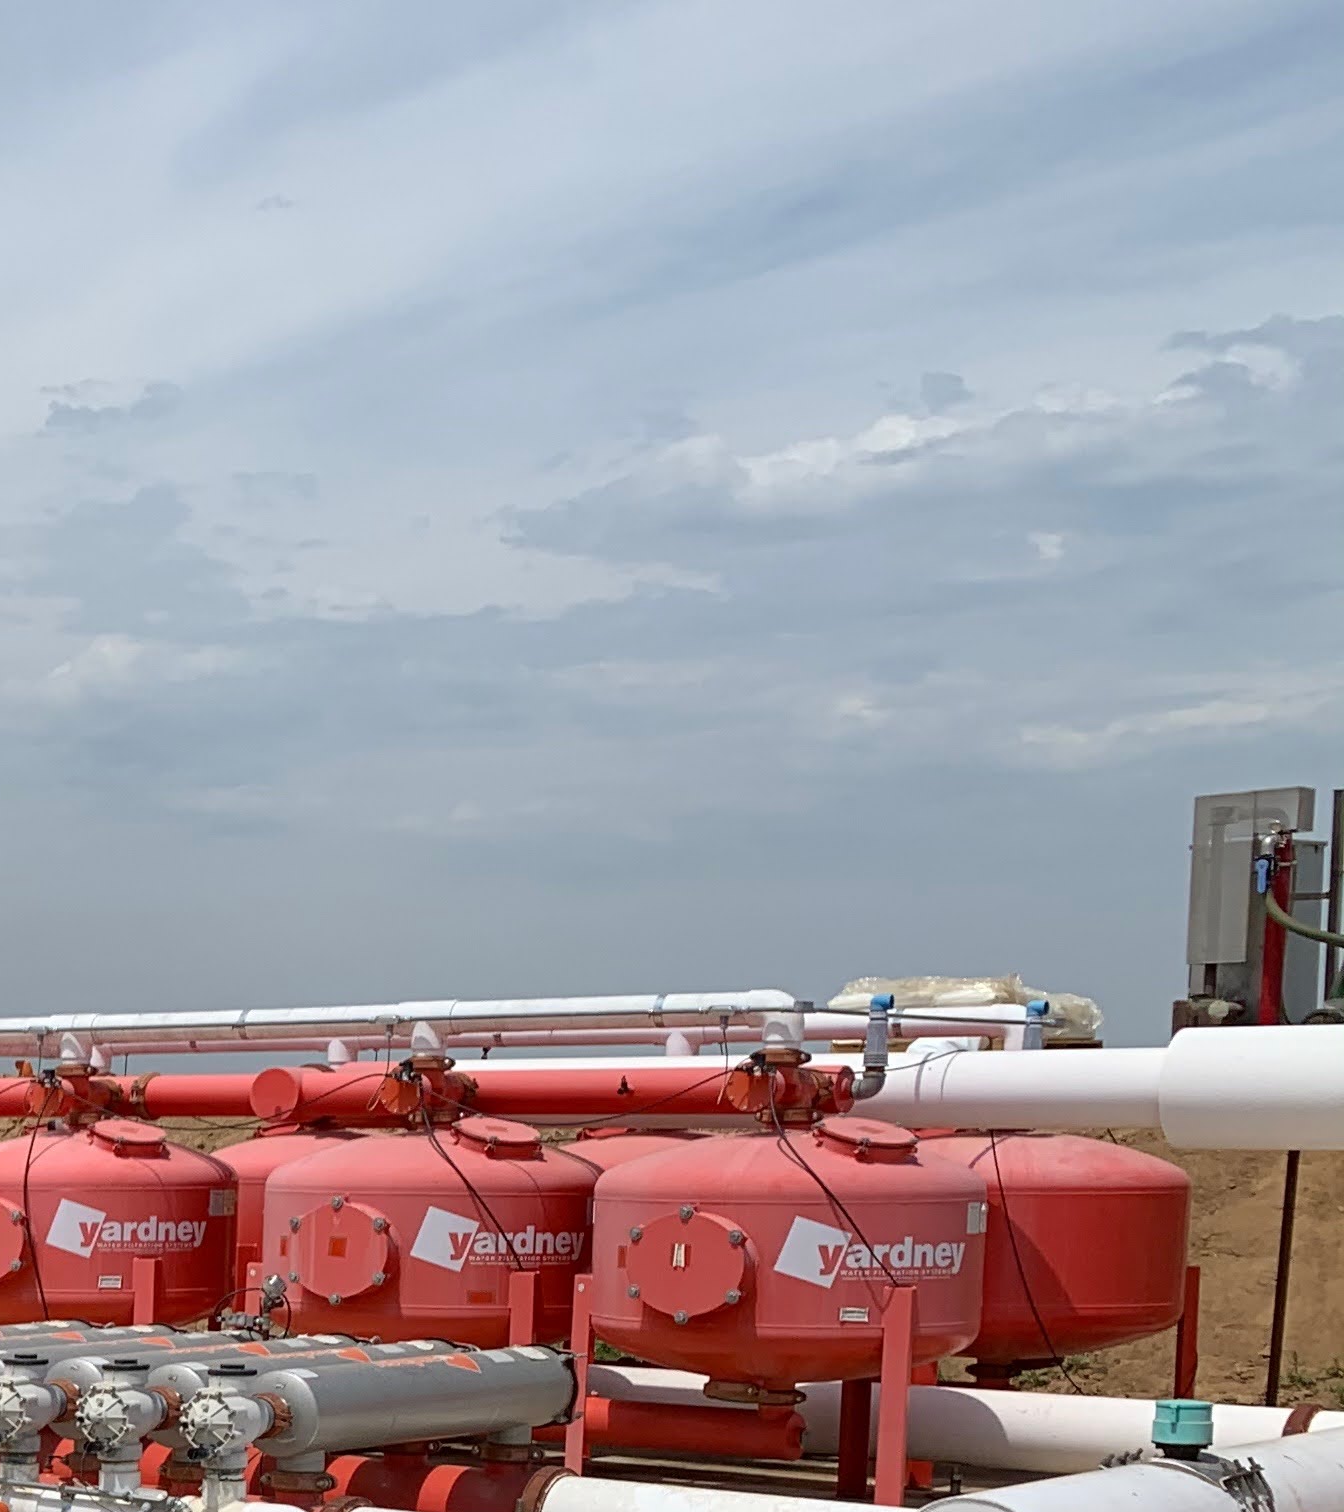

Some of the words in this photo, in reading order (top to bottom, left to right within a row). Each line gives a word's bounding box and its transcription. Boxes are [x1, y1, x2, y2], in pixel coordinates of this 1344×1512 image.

[78, 1215, 207, 1248] yardney
[449, 1225, 585, 1261] yardney
[818, 1236, 966, 1276] yardney
